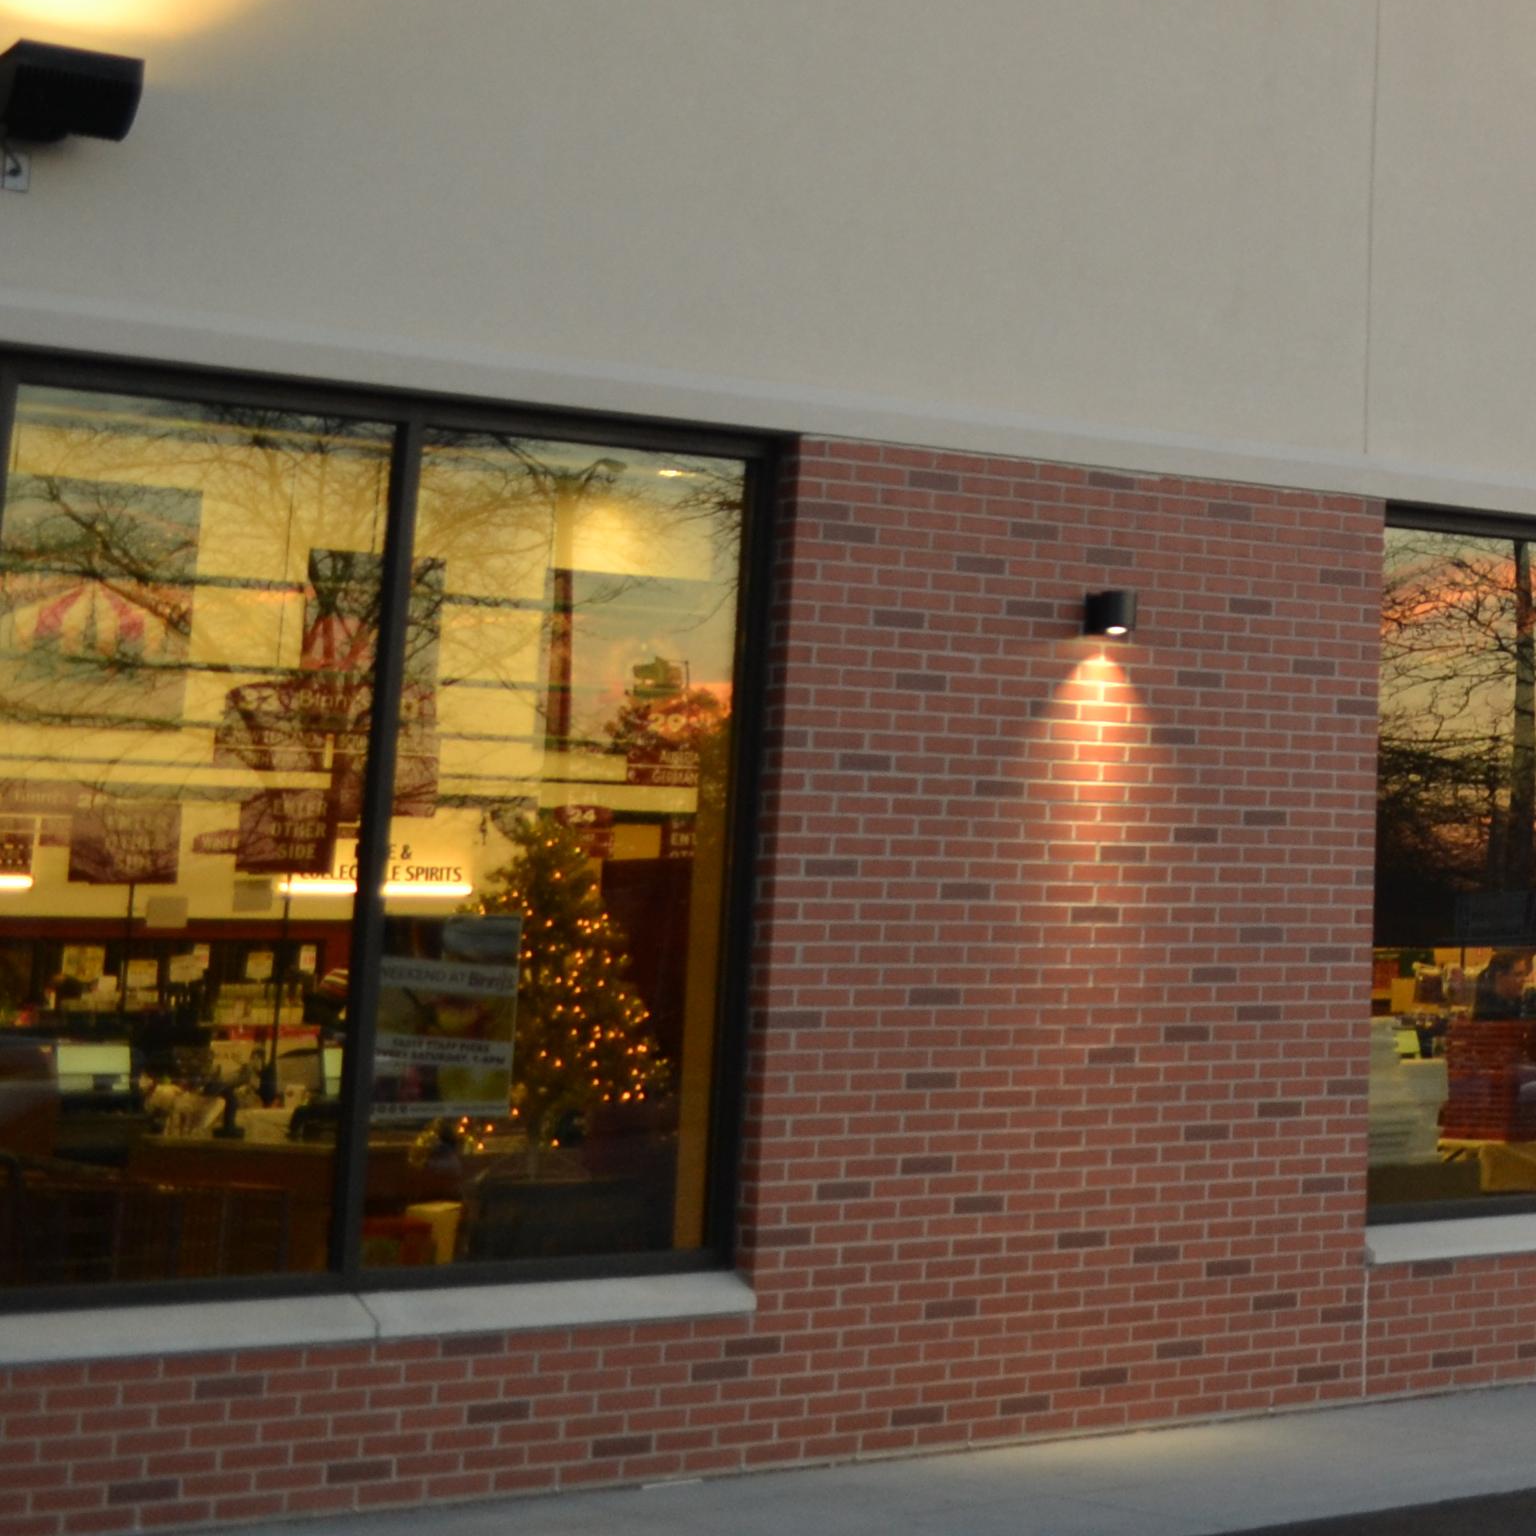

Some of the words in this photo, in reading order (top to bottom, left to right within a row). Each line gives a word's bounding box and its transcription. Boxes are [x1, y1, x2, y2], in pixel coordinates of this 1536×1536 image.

[271, 821, 327, 838] OTHER
[400, 844, 412, 860] &
[405, 865, 463, 882] SPIRITS
